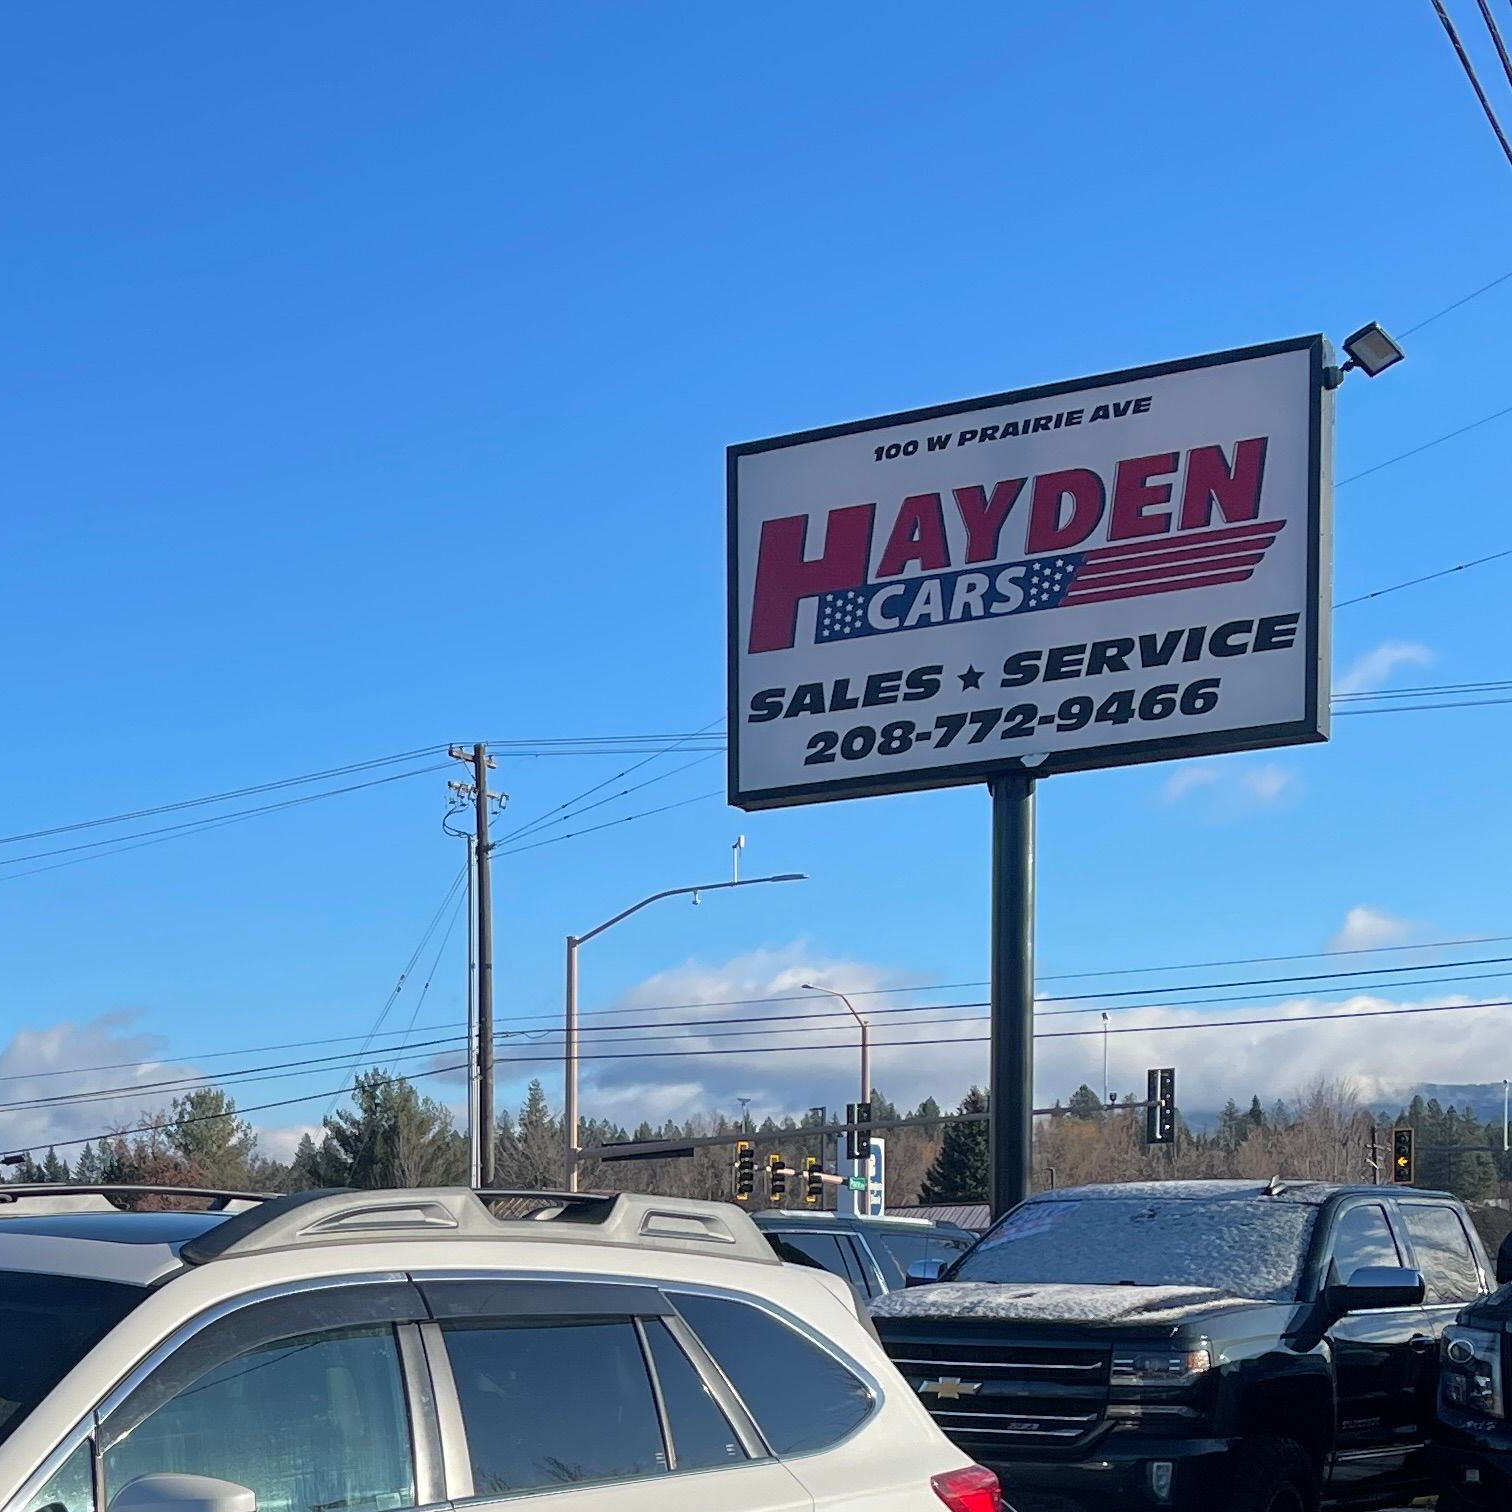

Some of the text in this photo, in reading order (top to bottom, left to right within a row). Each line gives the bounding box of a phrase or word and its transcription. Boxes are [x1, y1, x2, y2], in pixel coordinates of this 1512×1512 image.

[873, 396, 1153, 462] 100 W PRAIRIE AVE
[748, 436, 1269, 655] HAYDEN
[866, 566, 1028, 632] CARS
[748, 611, 1300, 723] SALES SERVICE
[803, 678, 1221, 767] 208-772-9466
